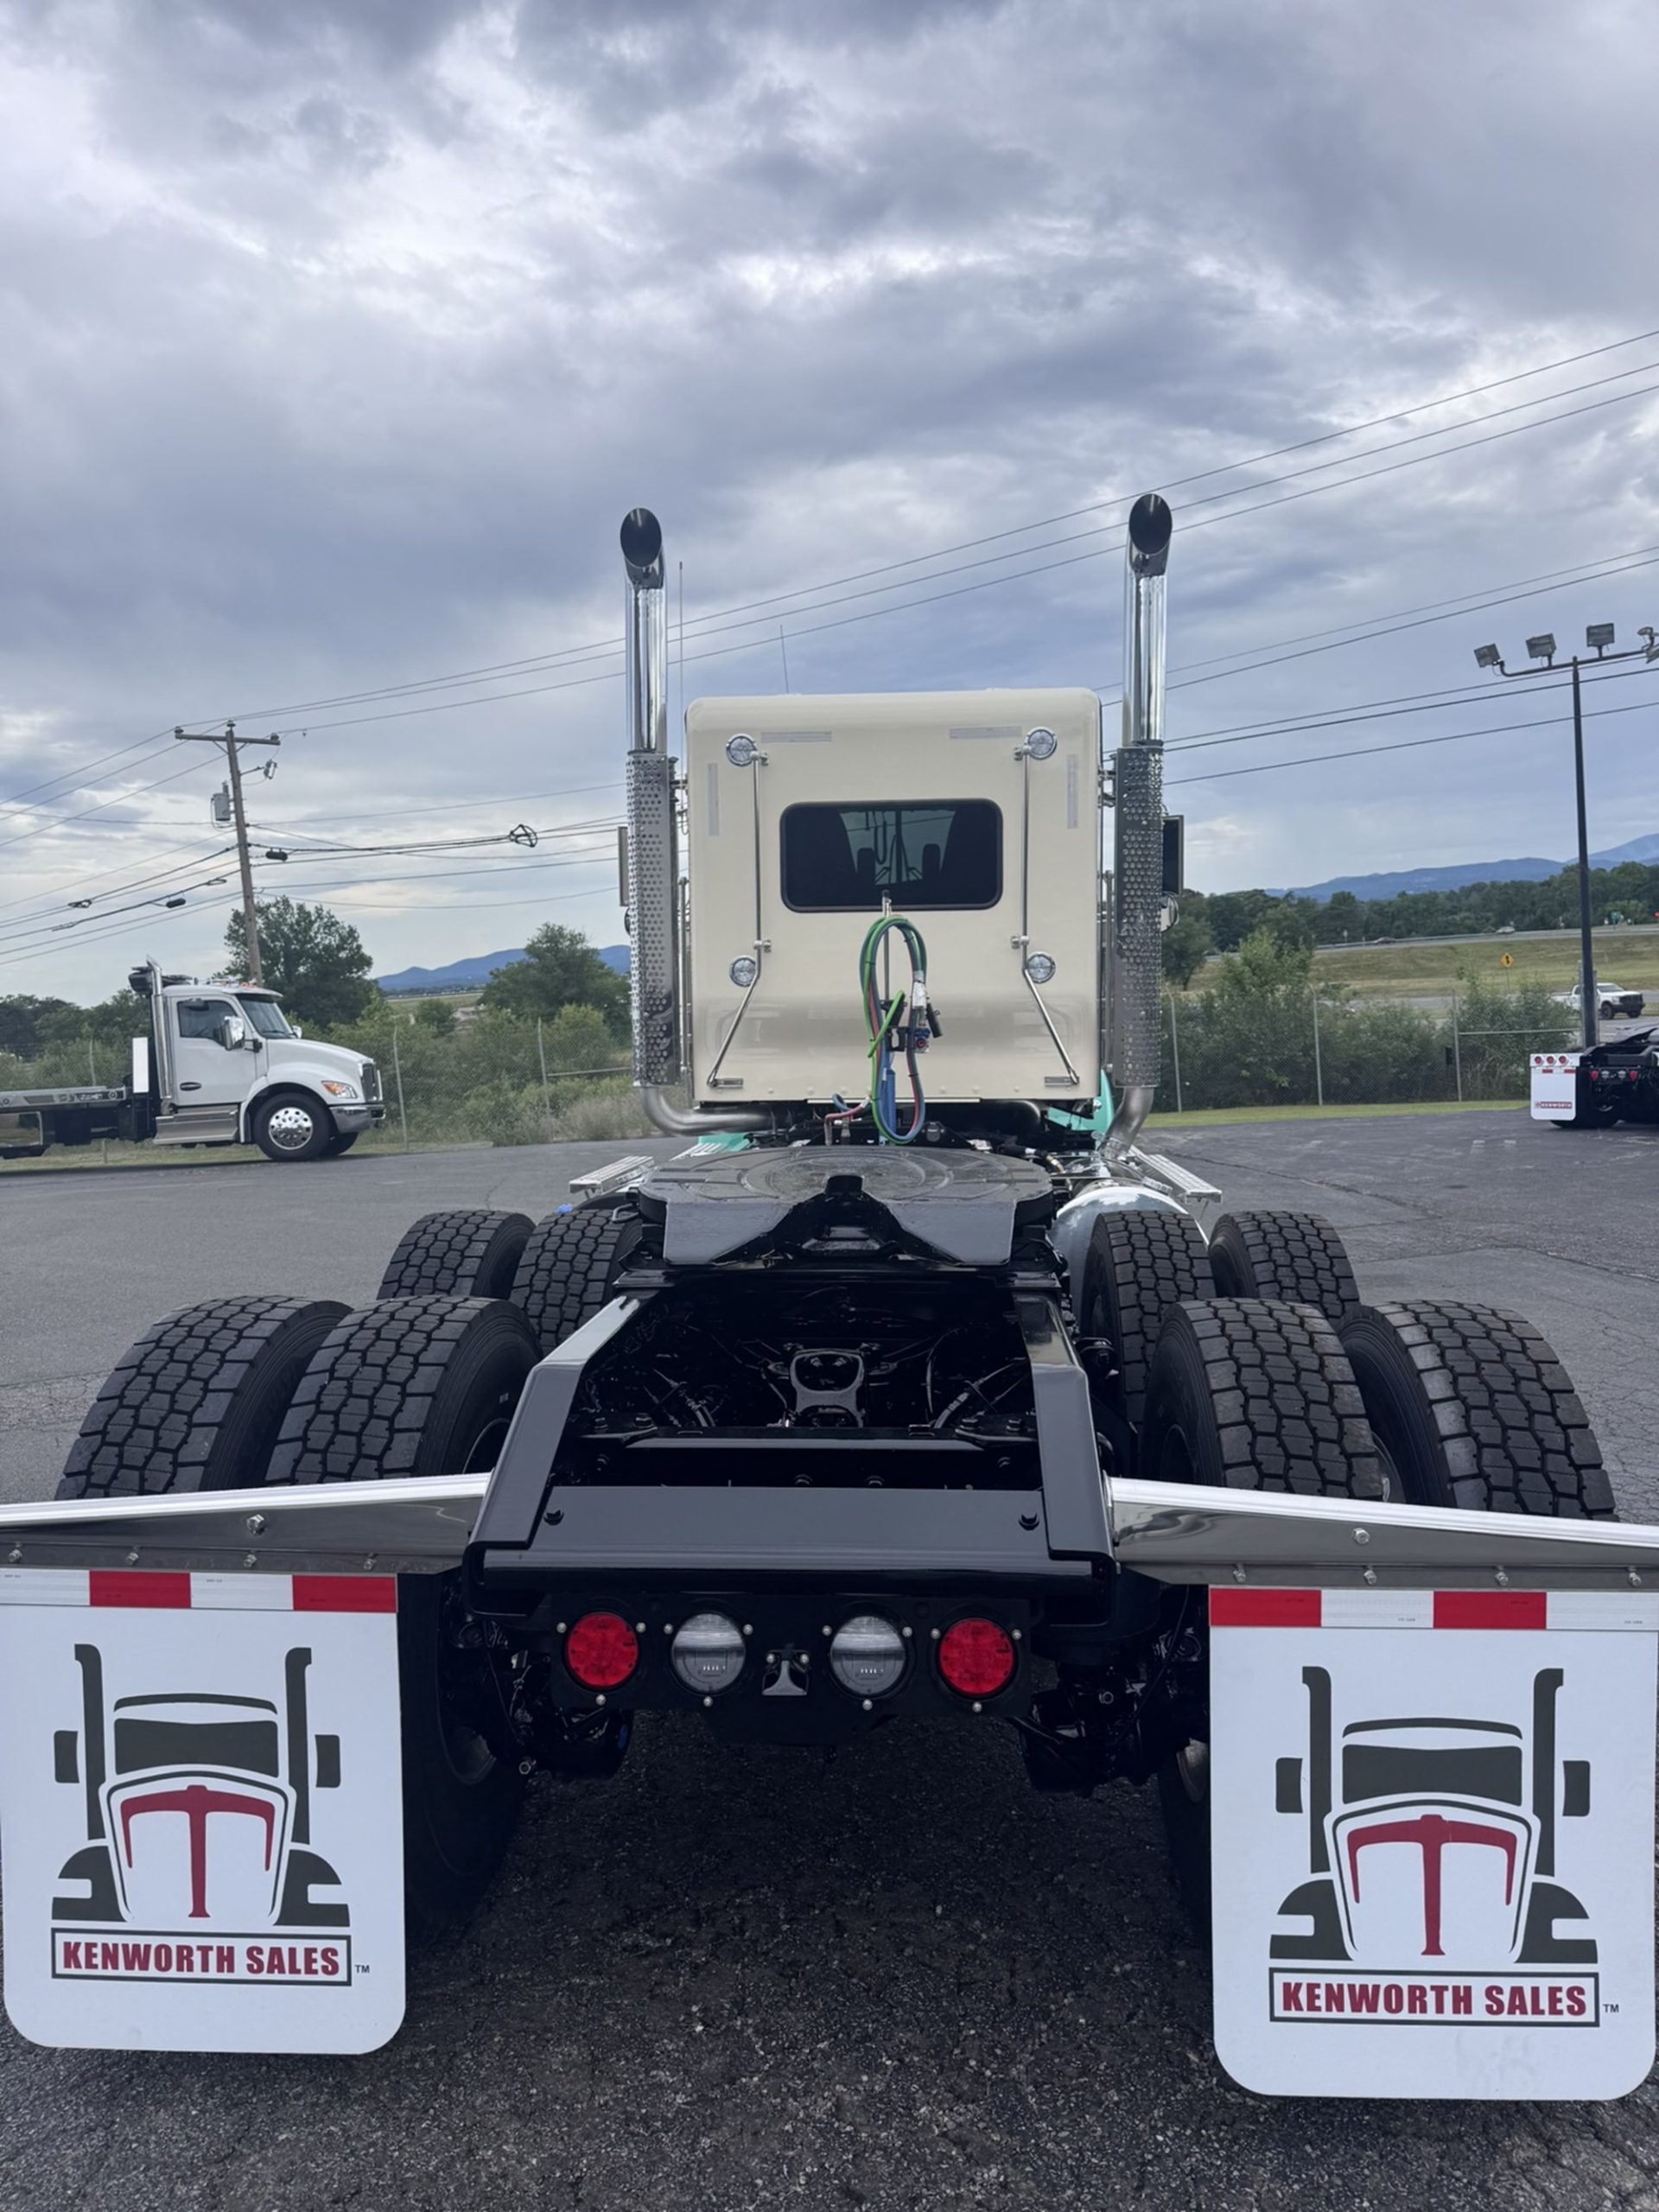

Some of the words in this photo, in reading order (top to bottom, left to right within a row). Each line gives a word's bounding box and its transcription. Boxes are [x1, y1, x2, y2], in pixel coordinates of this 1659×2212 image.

[63, 1942, 235, 1973] KENWORTH
[246, 1946, 340, 1976] SALES
[1282, 1982, 1472, 2015] KENWORTH
[1484, 1985, 1586, 2016] SALES
